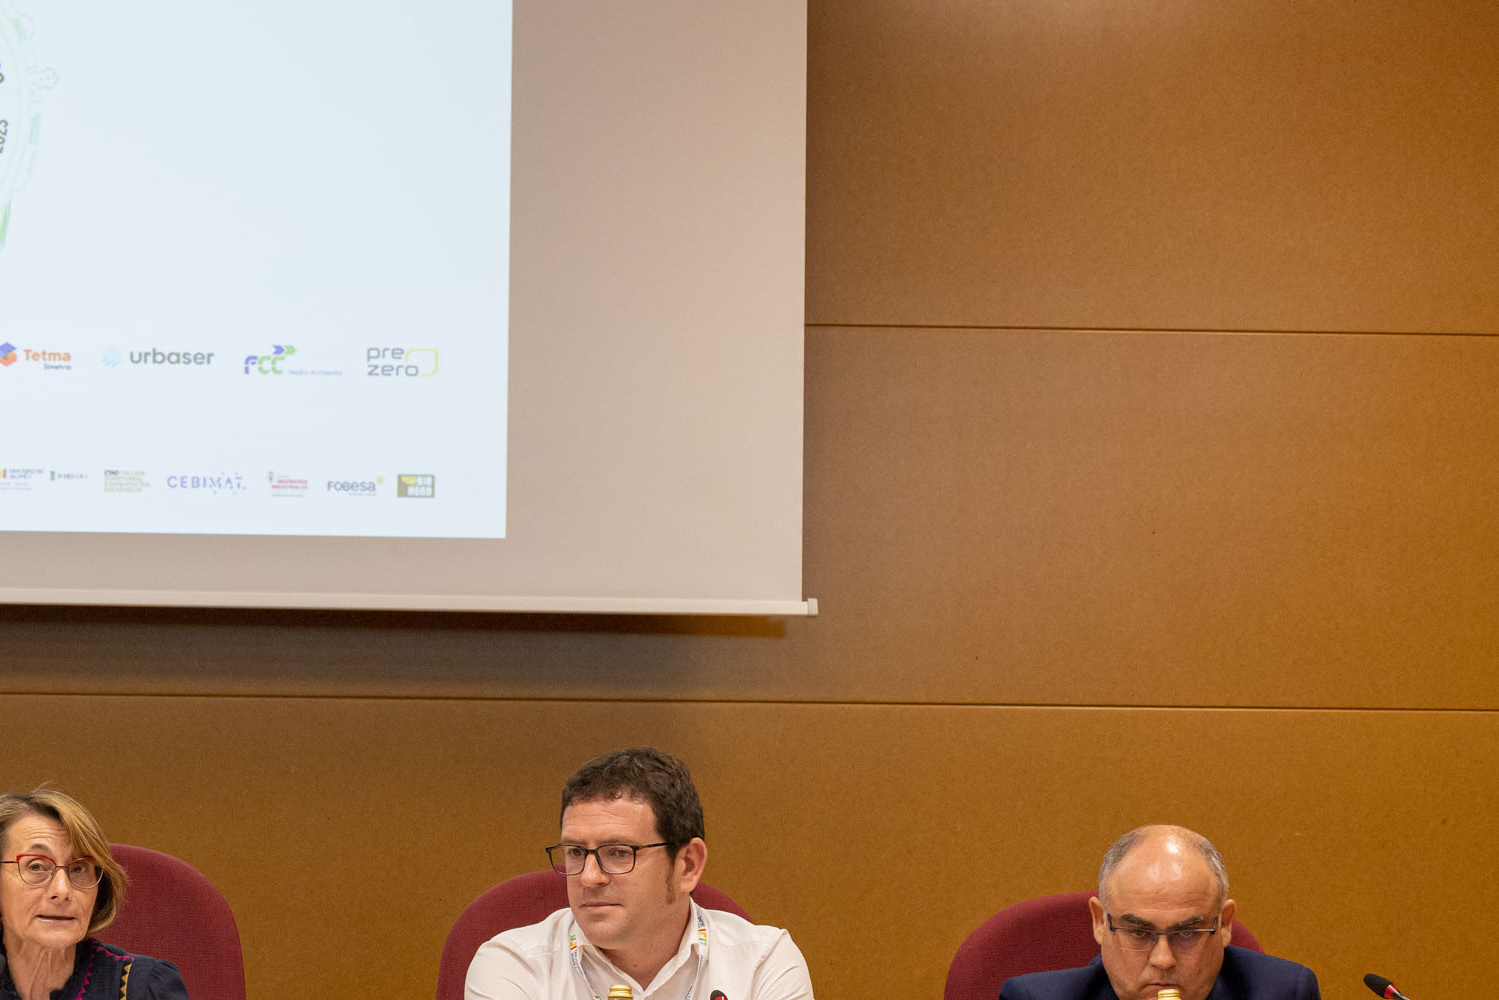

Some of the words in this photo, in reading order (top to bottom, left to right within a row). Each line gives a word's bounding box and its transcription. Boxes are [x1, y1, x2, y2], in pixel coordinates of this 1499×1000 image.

[25, 349, 71, 361] Tetma
[129, 348, 215, 365] urbaser
[367, 347, 404, 362] pre
[367, 364, 418, 376] zero
[167, 471, 247, 494] CEBIMAT
